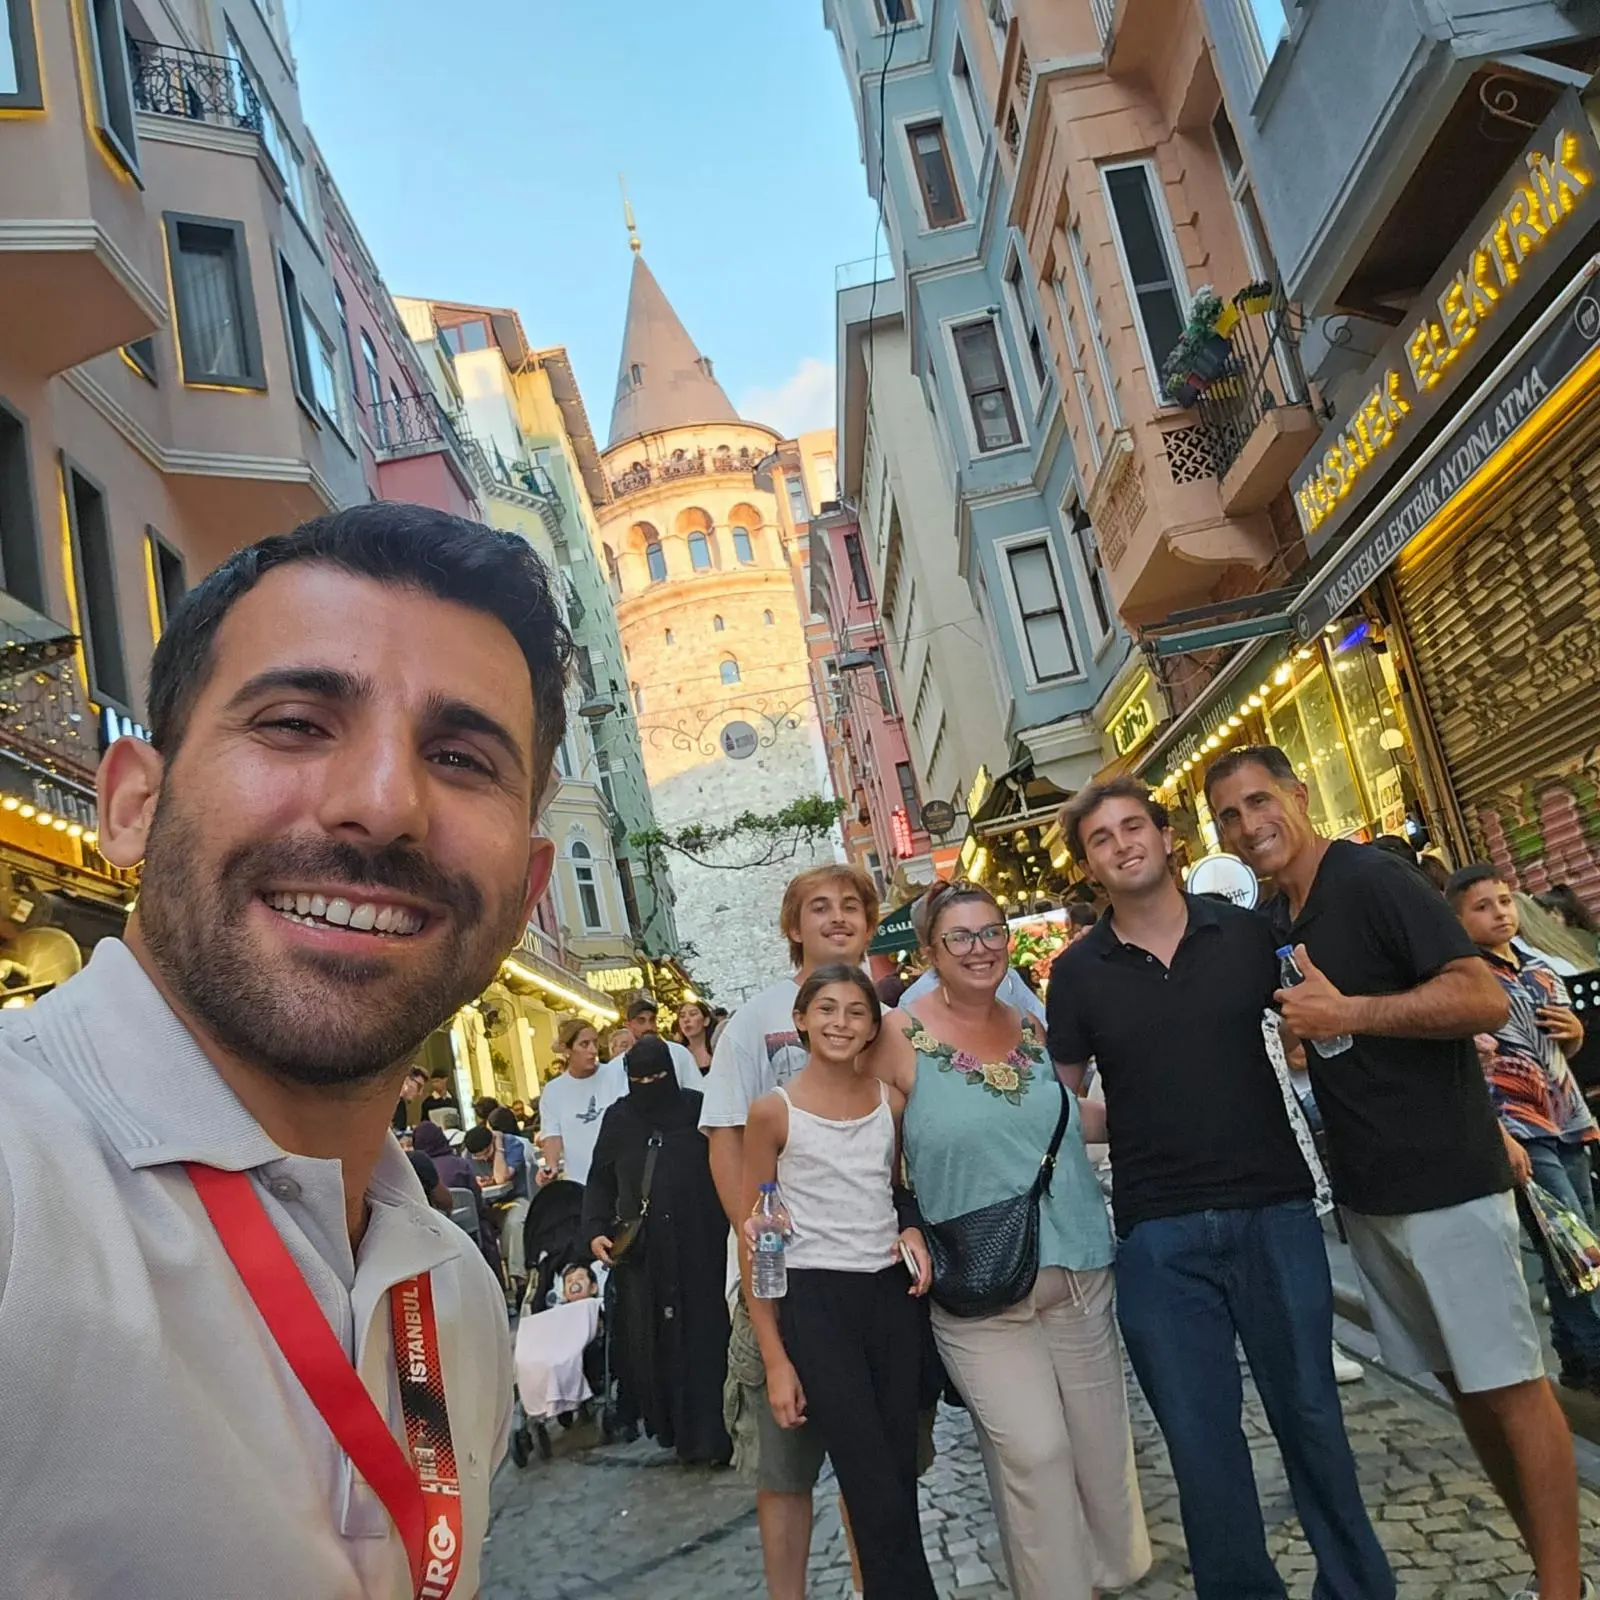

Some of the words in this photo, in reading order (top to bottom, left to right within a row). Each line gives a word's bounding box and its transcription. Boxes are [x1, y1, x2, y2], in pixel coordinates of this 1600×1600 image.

[1404, 128, 1588, 392] ELEKTRİK
[1324, 544, 1378, 615] MUSATEK
[1374, 480, 1441, 566] ELEKTRİK
[1440, 365, 1549, 499] AYDINLATMA
[402, 1287, 427, 1383] İSTANBUL
